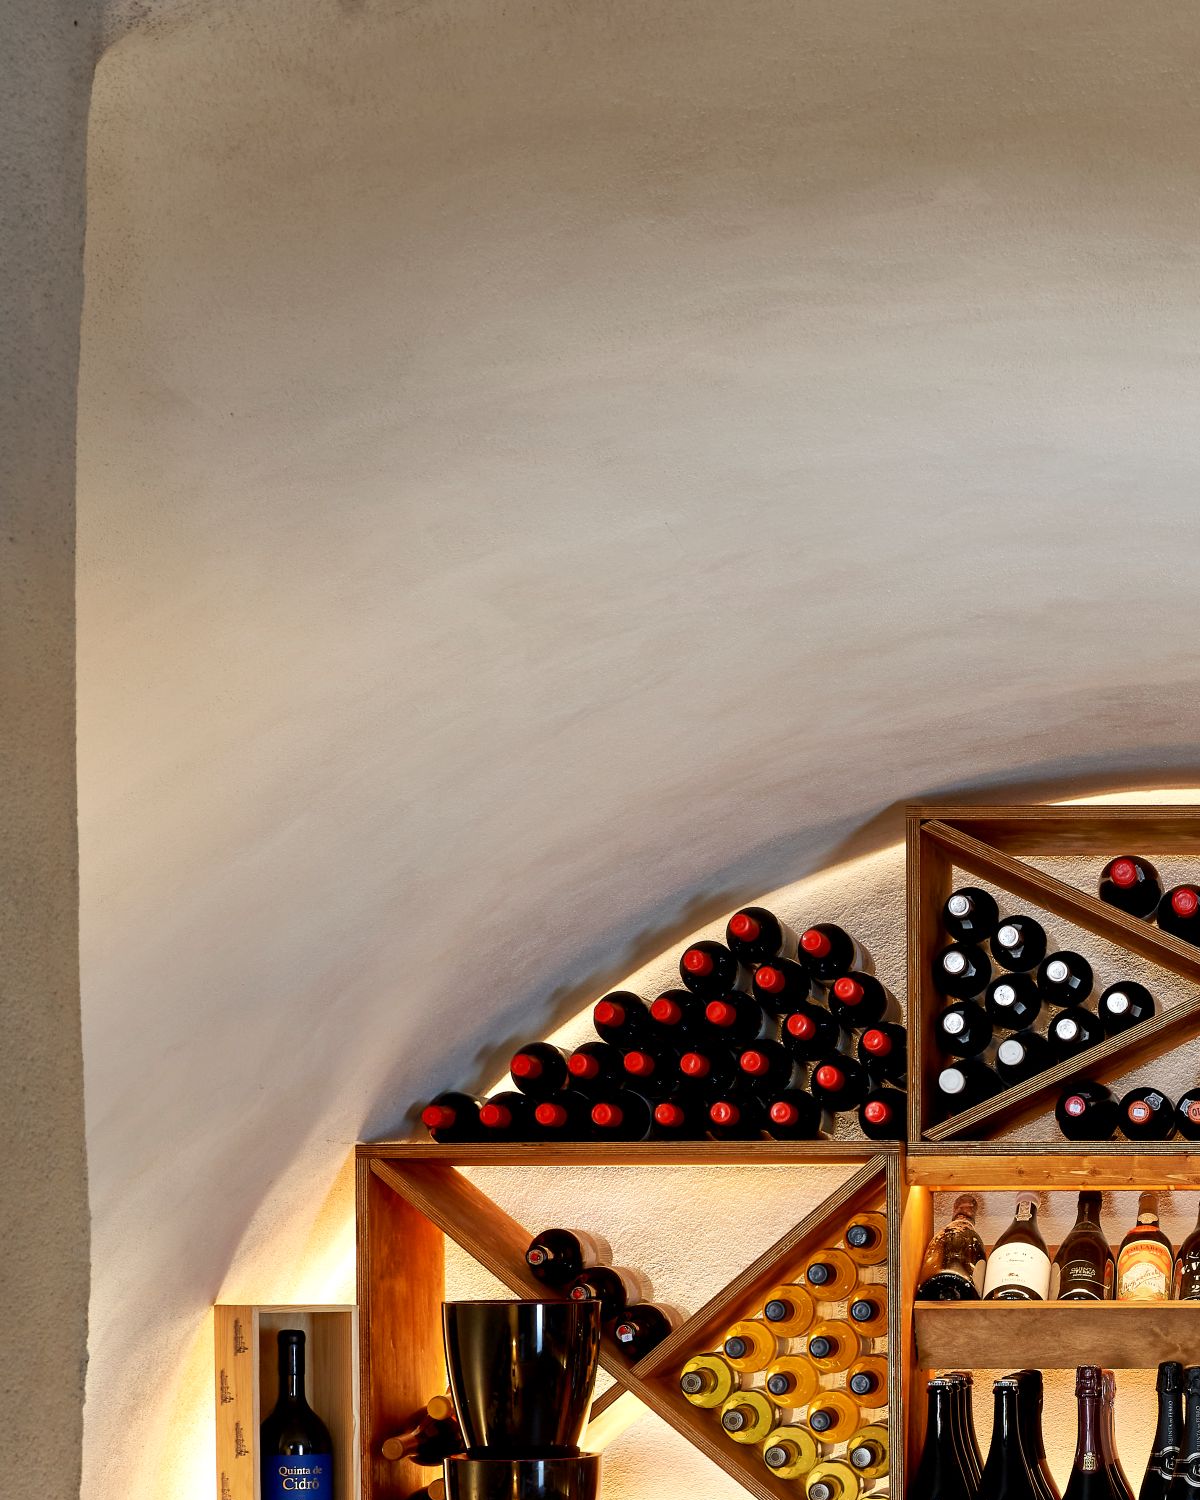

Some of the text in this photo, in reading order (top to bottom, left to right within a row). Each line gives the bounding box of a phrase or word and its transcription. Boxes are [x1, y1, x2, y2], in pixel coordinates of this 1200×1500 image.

[279, 1465, 322, 1476] Quinta de
[282, 1477, 320, 1490] Cidrô
